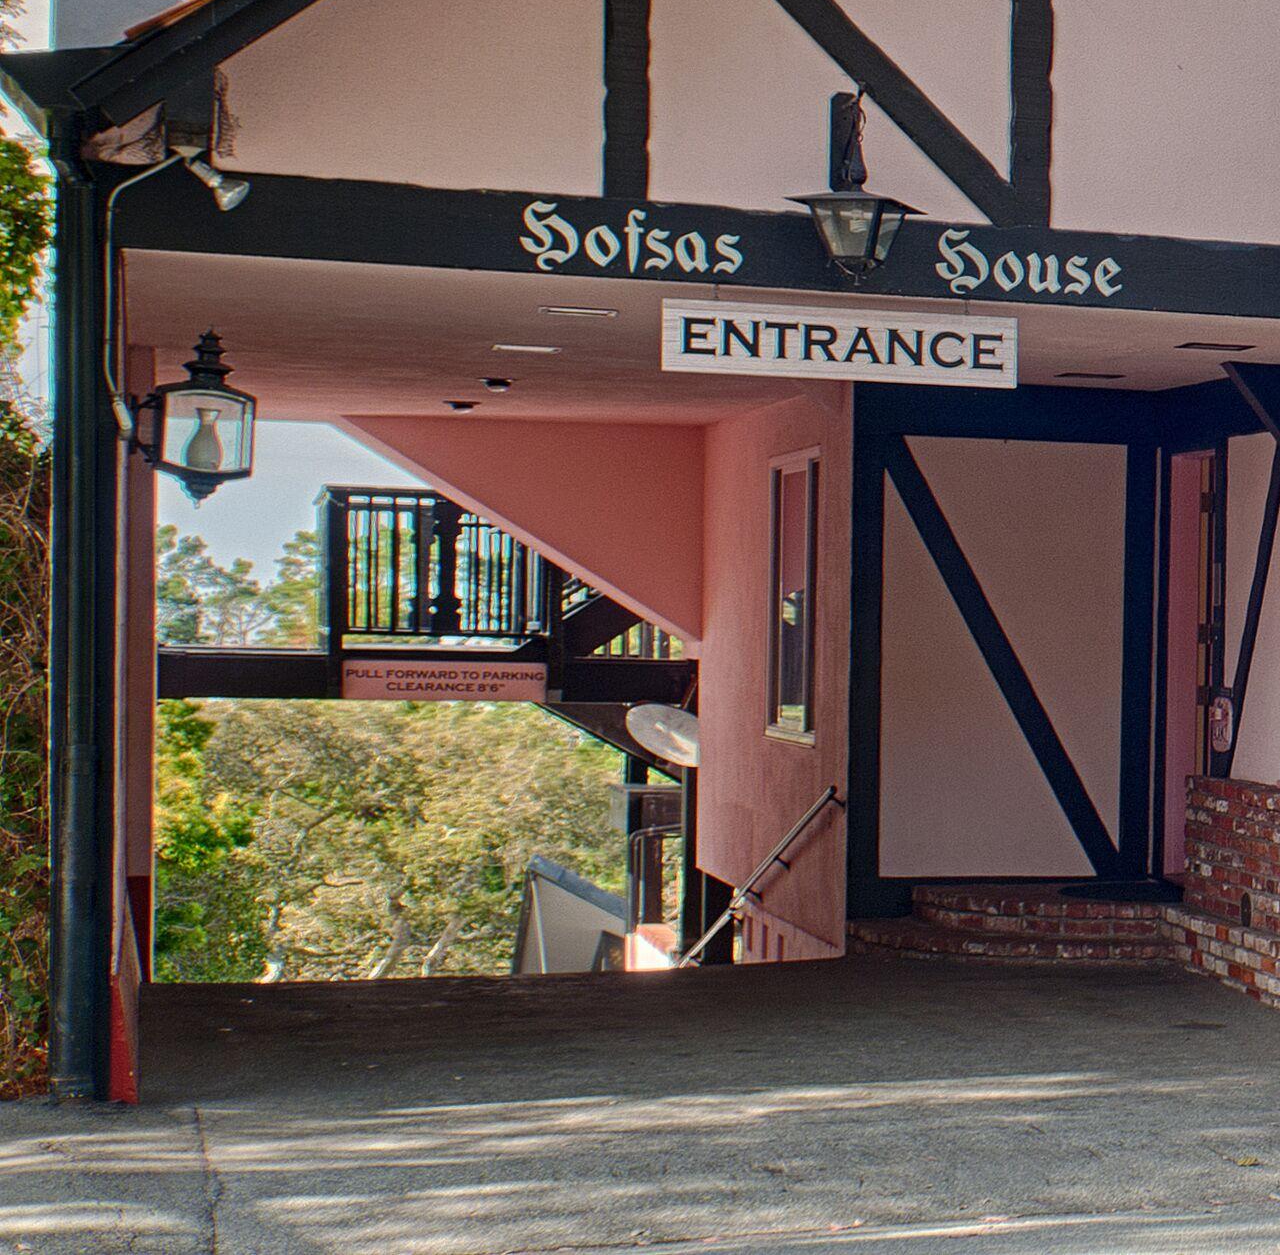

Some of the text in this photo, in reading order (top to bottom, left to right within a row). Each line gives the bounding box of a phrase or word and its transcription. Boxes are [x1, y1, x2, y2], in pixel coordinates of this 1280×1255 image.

[519, 200, 1122, 297] Hofsas House
[680, 316, 1005, 371] ENTRANCE
[346, 668, 544, 681] PULL FORWARD TO PARKING
[386, 682, 474, 692] CLEARANCE
